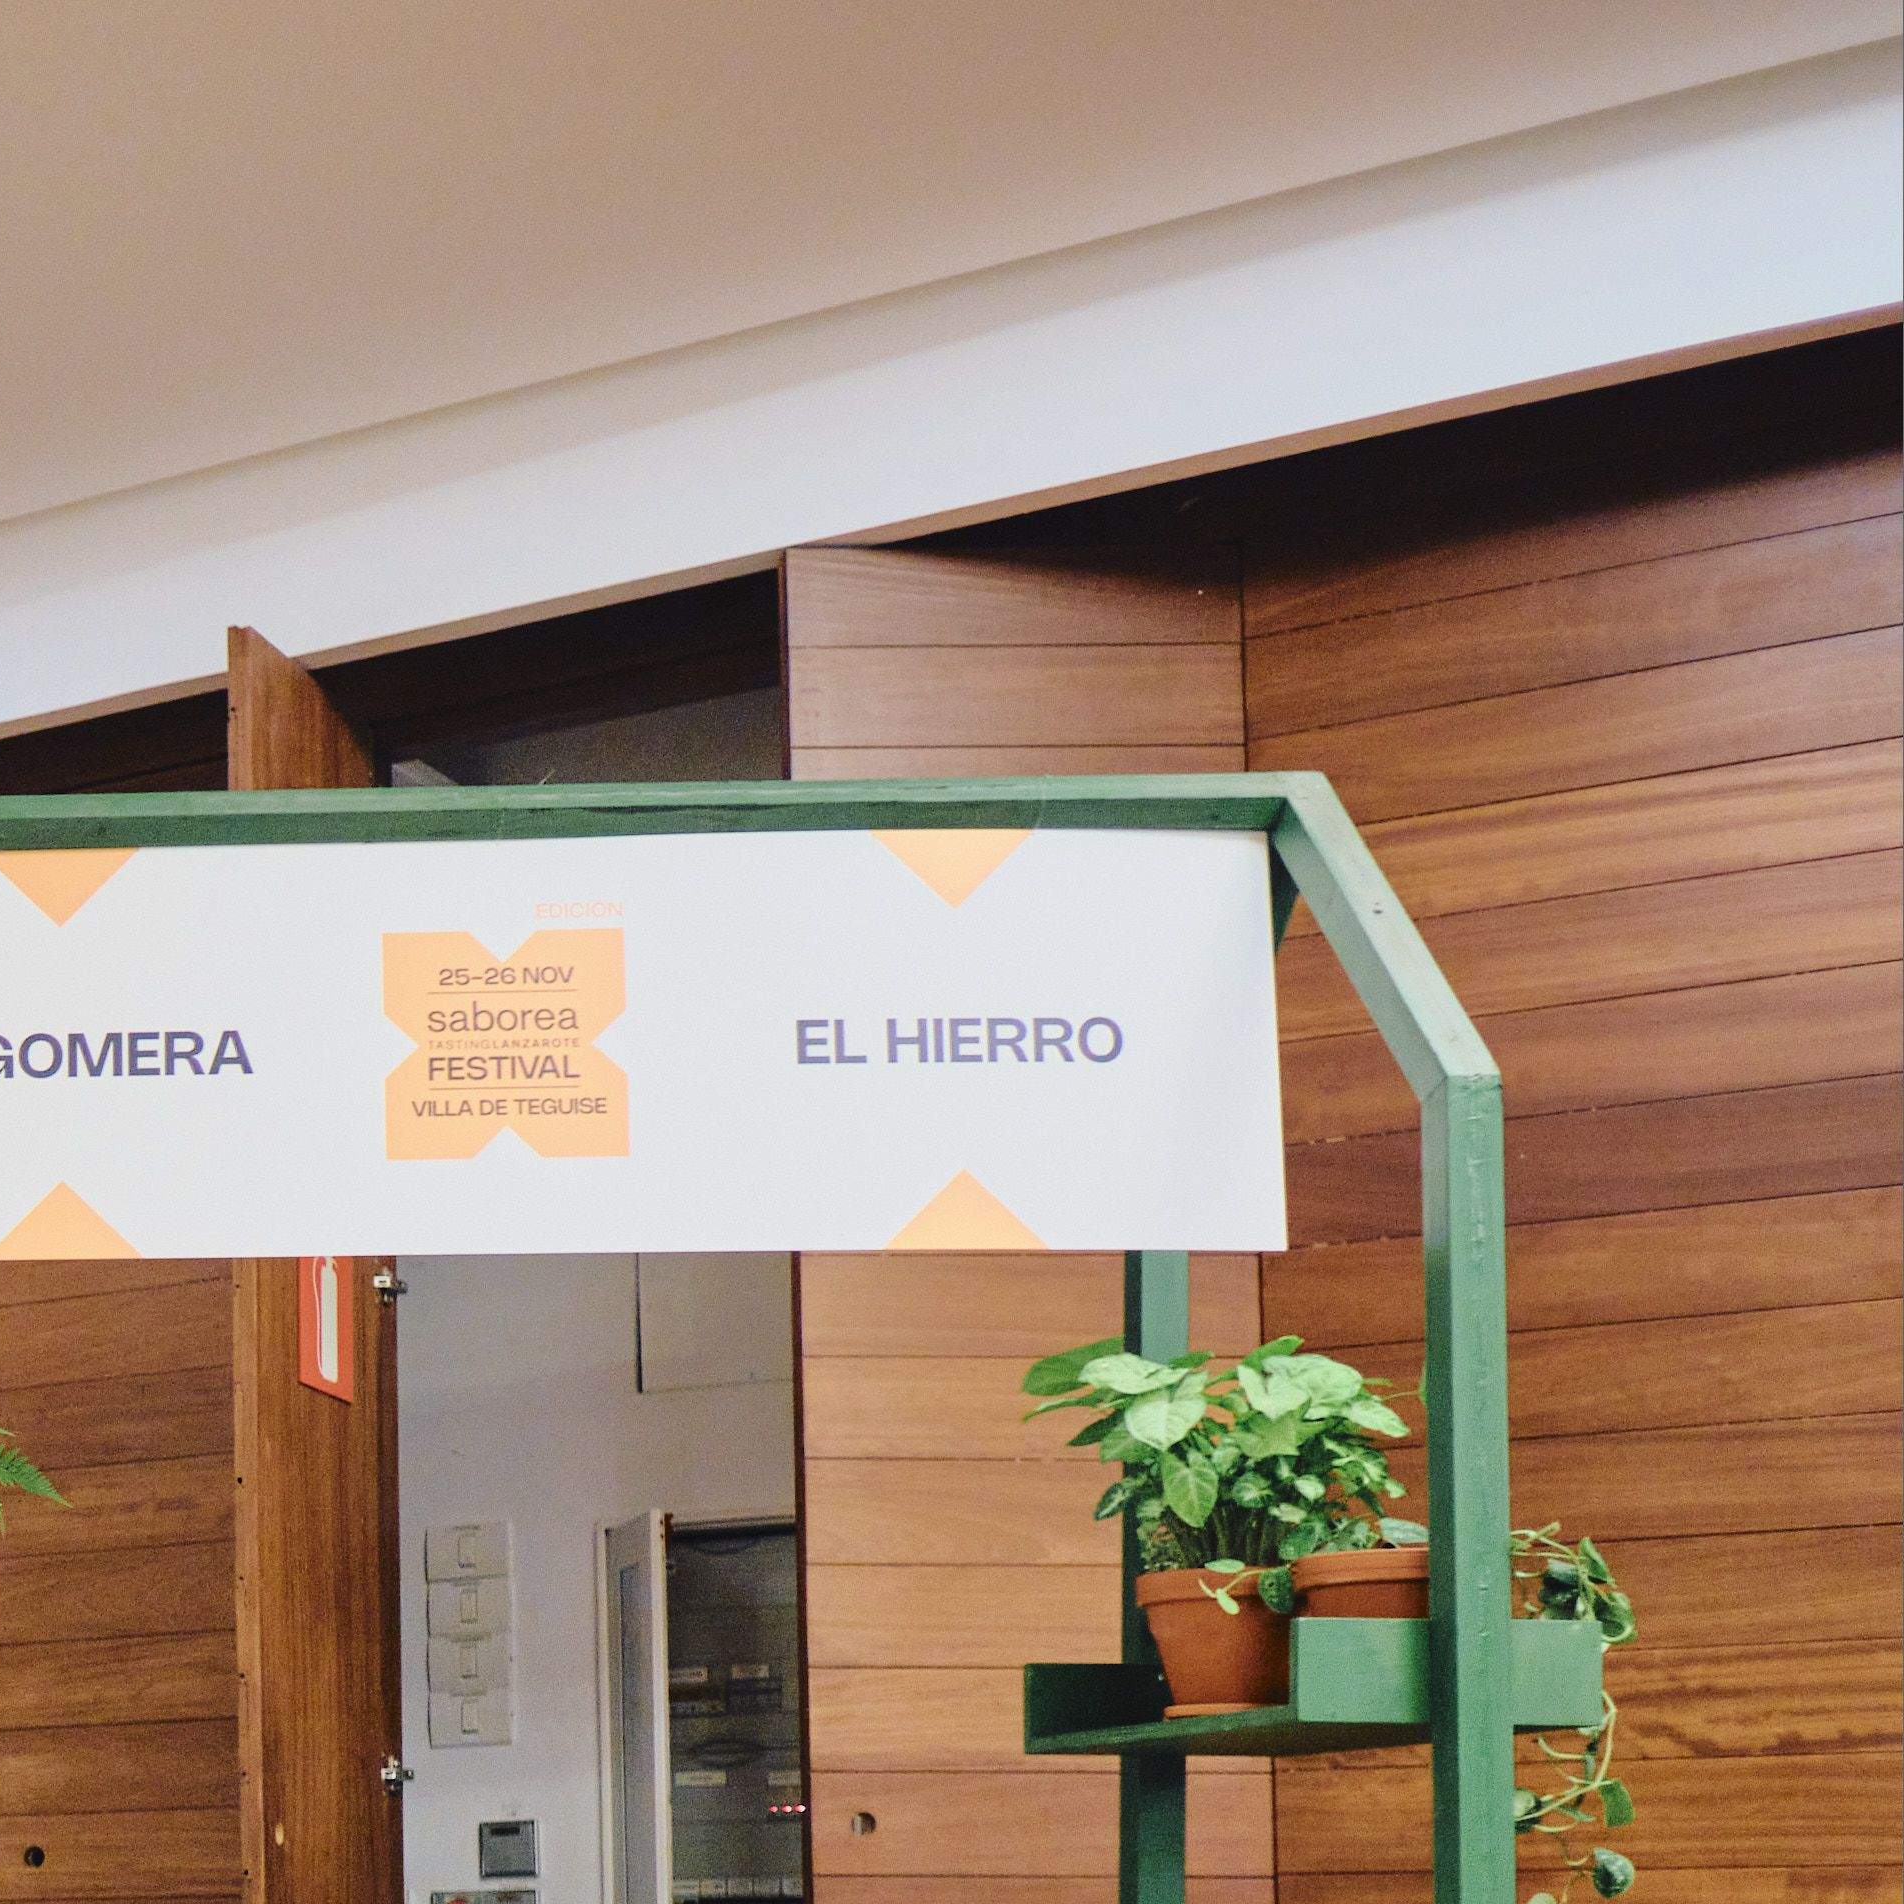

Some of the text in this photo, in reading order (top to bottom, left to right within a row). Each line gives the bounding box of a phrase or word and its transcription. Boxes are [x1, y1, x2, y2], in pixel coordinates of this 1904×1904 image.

[438, 966, 575, 986] 25-26 NOV
[427, 1001, 579, 1032] saborea
[796, 1016, 1124, 1064] EL HIERRO
[427, 1055, 581, 1081] FESTIVAL
[411, 1097, 608, 1117] VILLA DE TEGUISE
